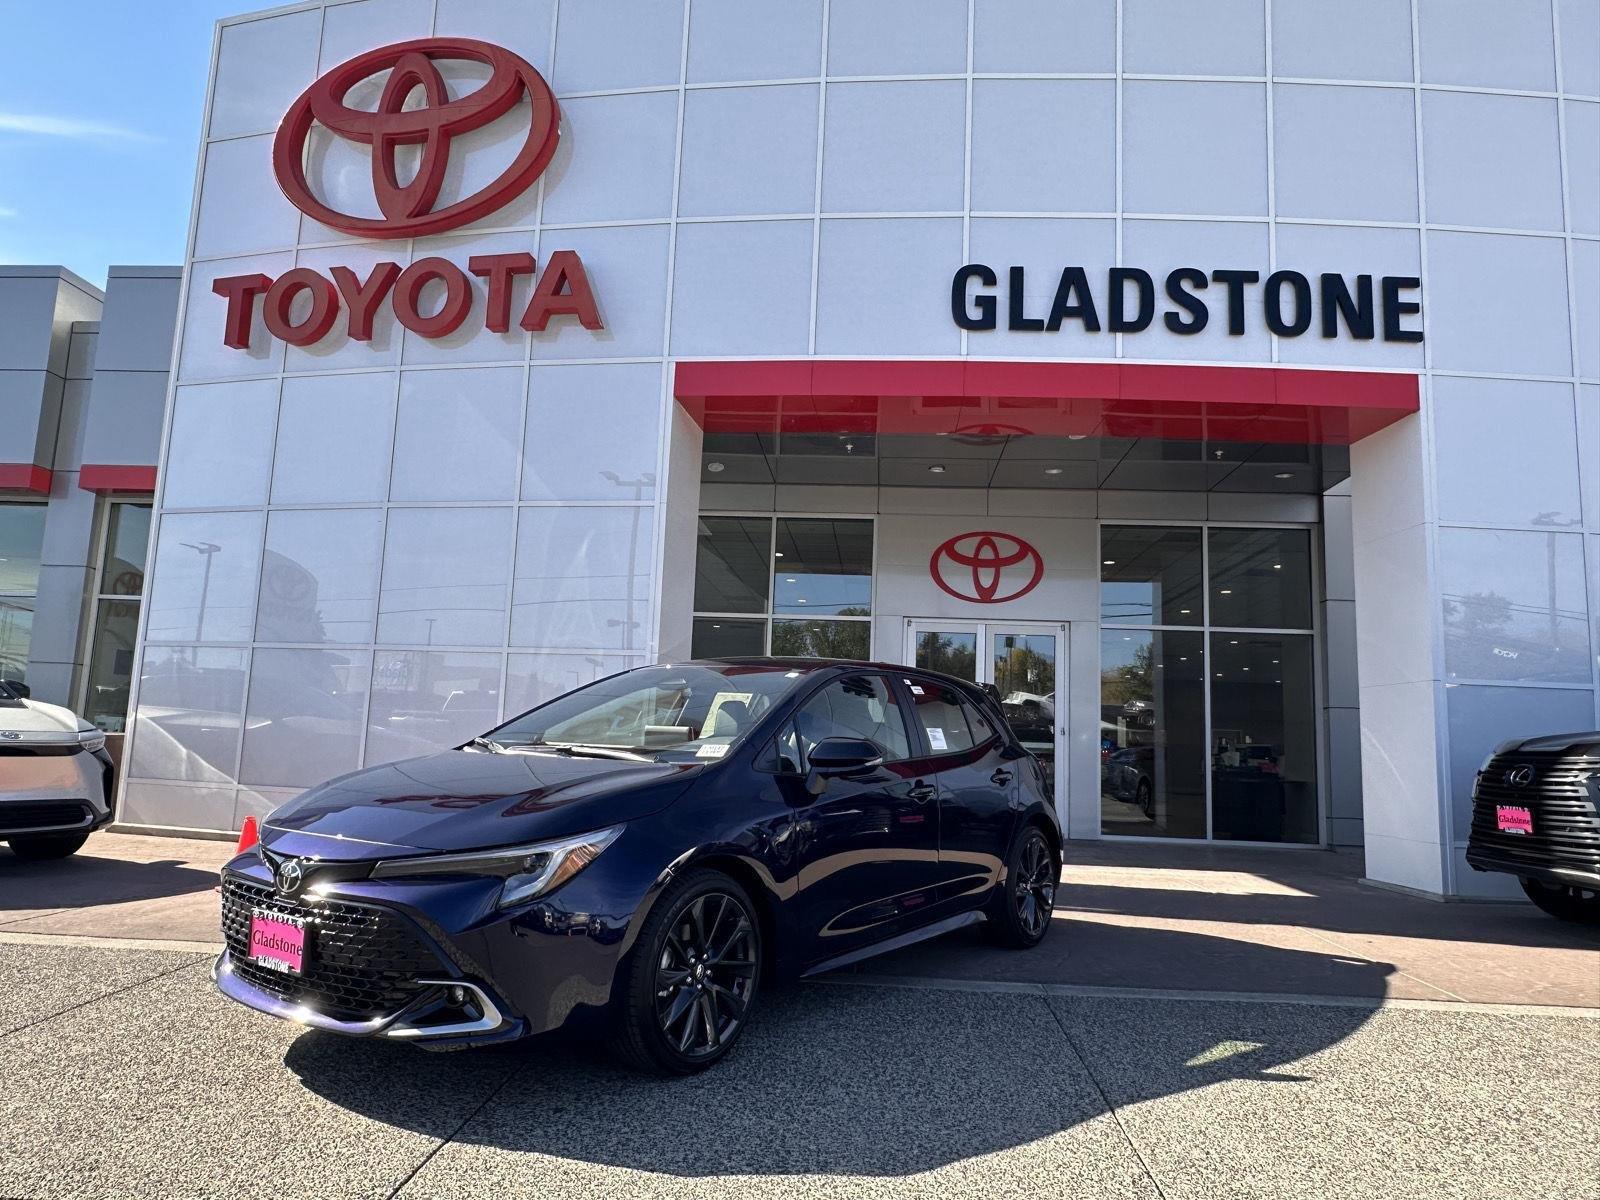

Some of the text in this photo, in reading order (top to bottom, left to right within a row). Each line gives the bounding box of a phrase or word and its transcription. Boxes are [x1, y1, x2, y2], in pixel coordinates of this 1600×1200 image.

[212, 250, 604, 350] TOYOTA
[951, 264, 1424, 343] GLADSTONE
[253, 930, 302, 956] Gladstone
